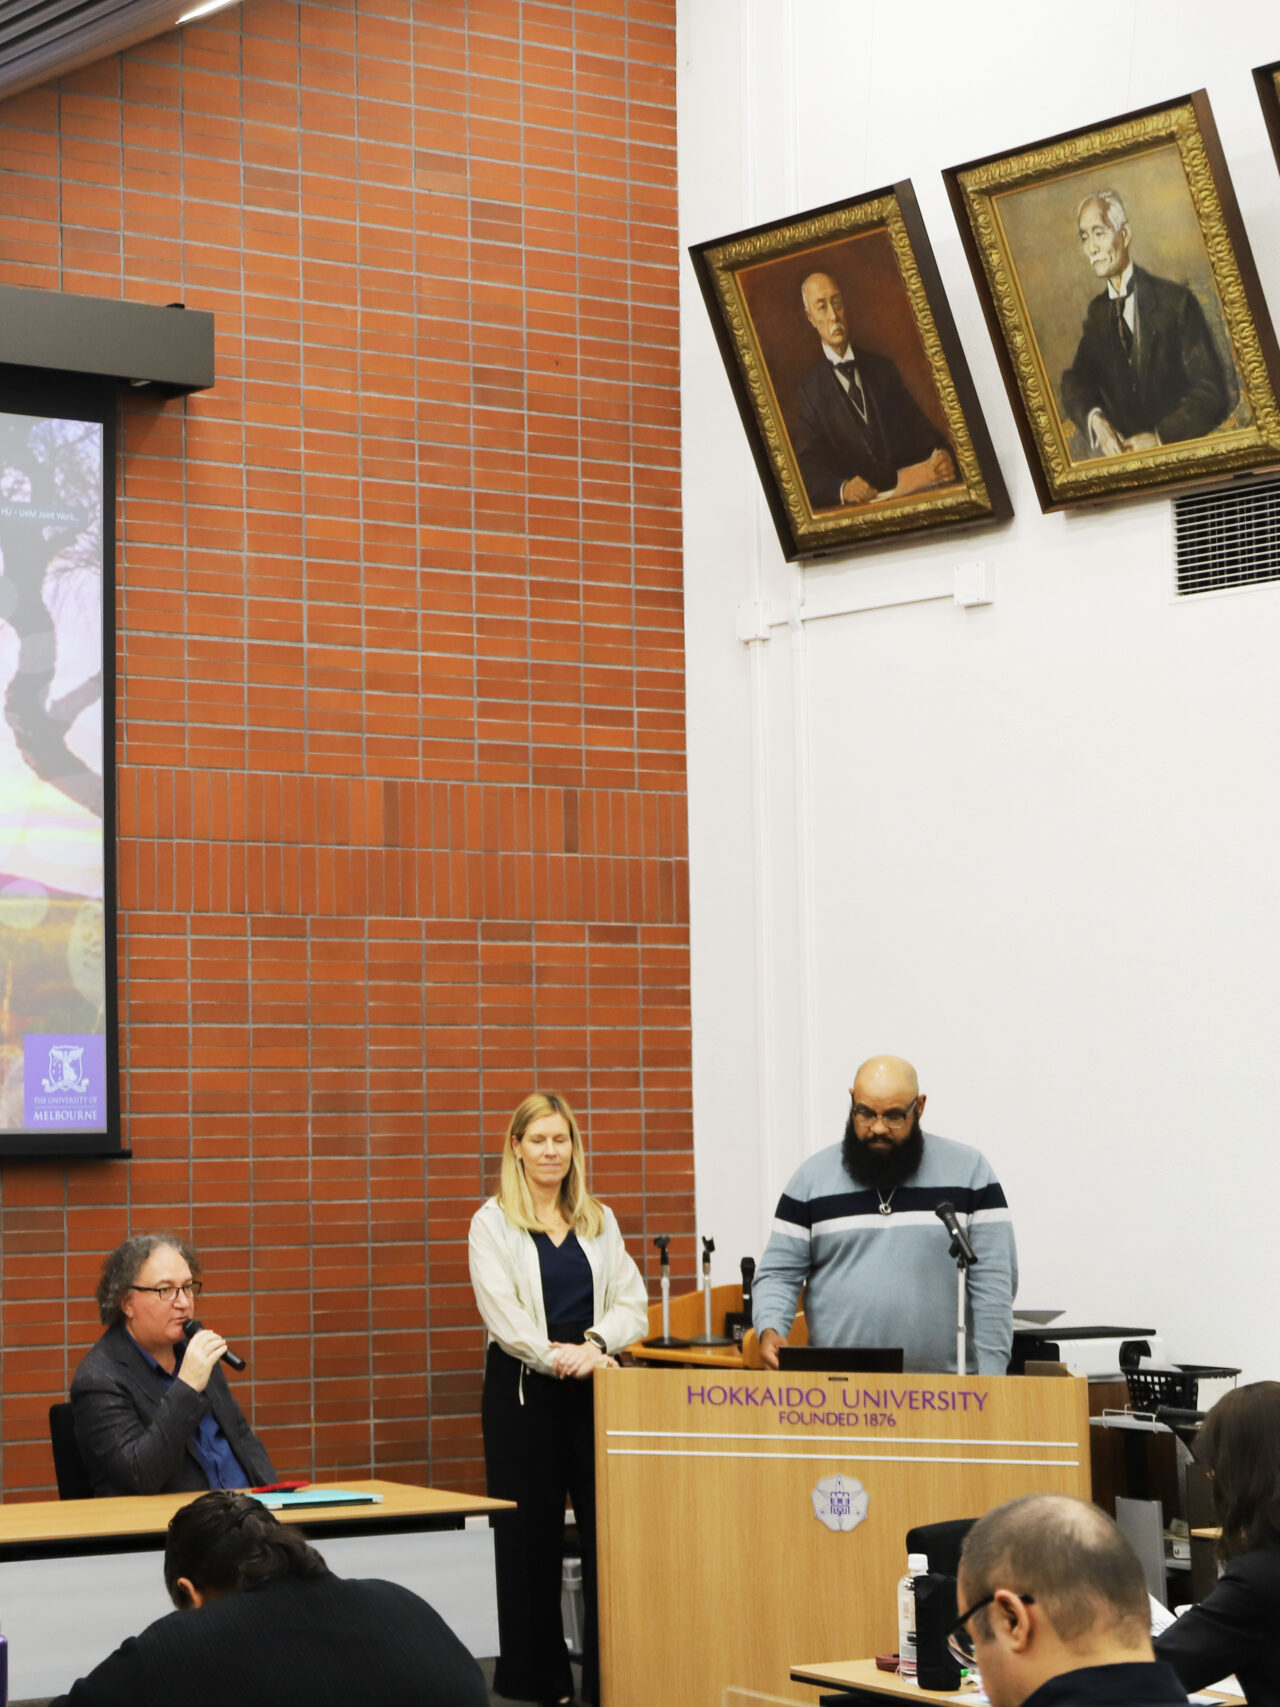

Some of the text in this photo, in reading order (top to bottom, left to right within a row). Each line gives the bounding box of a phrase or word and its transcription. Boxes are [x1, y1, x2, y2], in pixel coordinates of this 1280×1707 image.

[1, 507, 12, 516] HU
[38, 511, 55, 520] Joint
[34, 1096, 97, 1104] THE UNIVERSITY OF
[34, 1110, 97, 1120] MELBOURNE
[688, 1385, 989, 1412] HOKKAIDO UNIVERSITY
[779, 1411, 897, 1427] FOUNDED 1876
